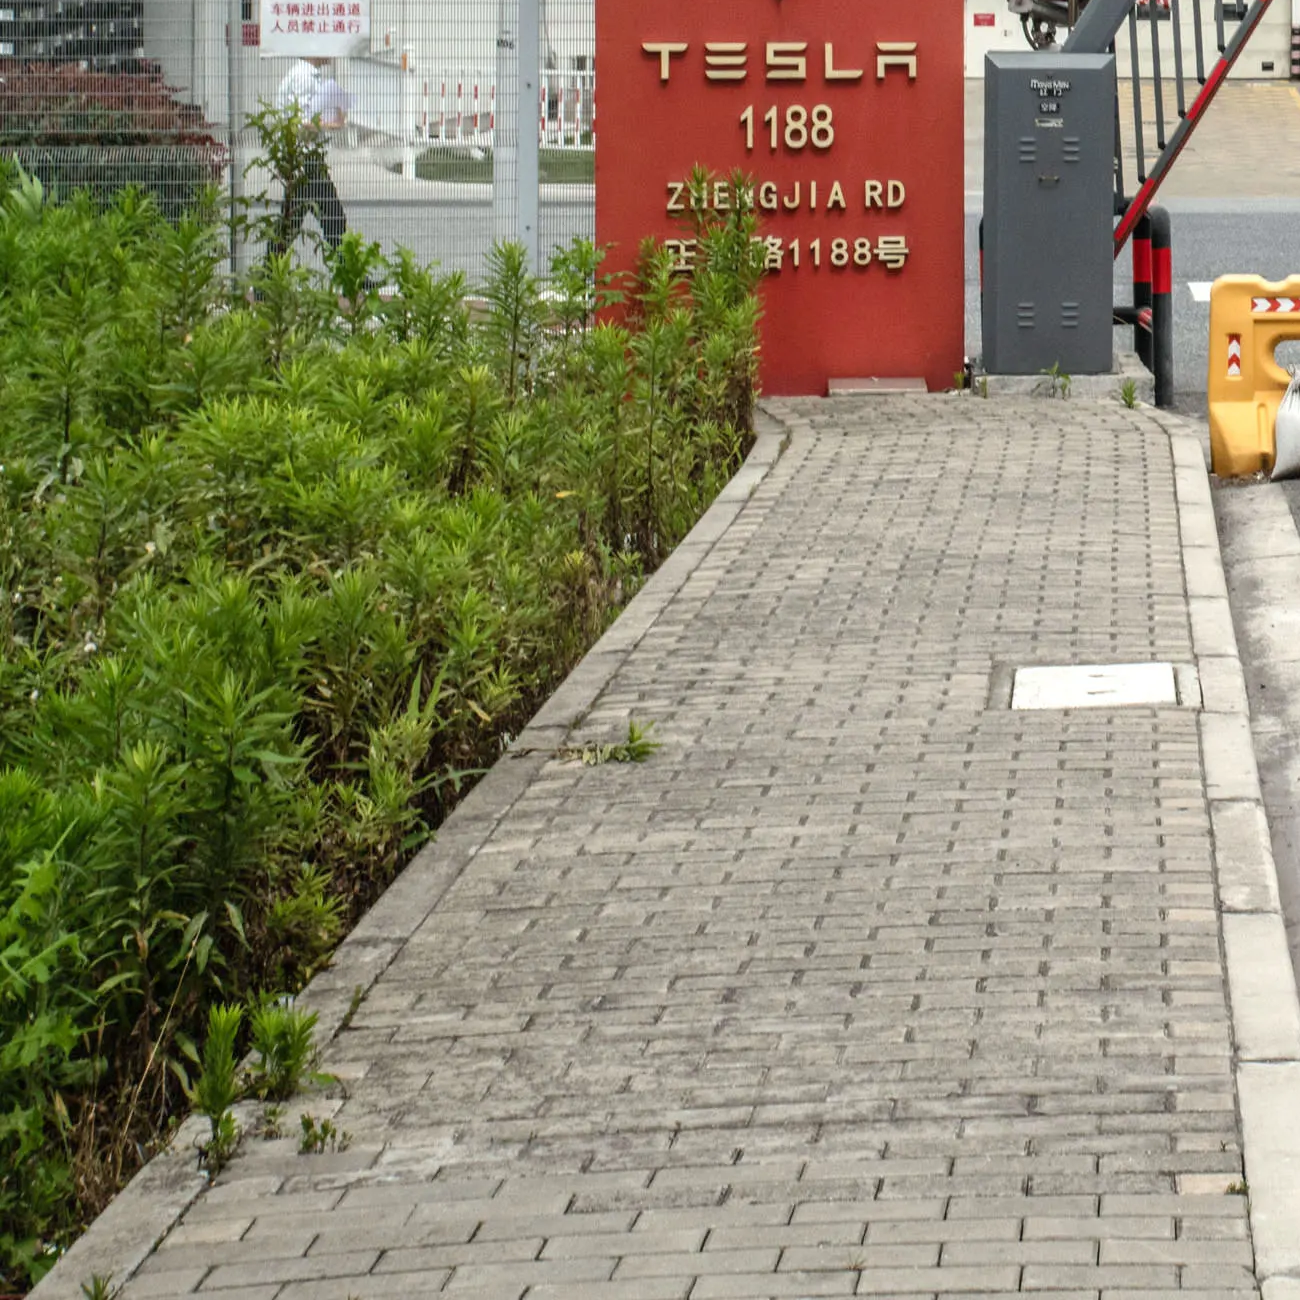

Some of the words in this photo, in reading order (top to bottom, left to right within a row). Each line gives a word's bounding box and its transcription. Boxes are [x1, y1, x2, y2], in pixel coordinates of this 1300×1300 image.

[271, 2, 361, 17] 车辆进出通道
[271, 19, 361, 34] 人员禁止通行
[641, 42, 918, 80] TESLA
[740, 104, 835, 149] 1188
[865, 179, 906, 209] RD
[663, 235, 910, 271] 正路1188号
